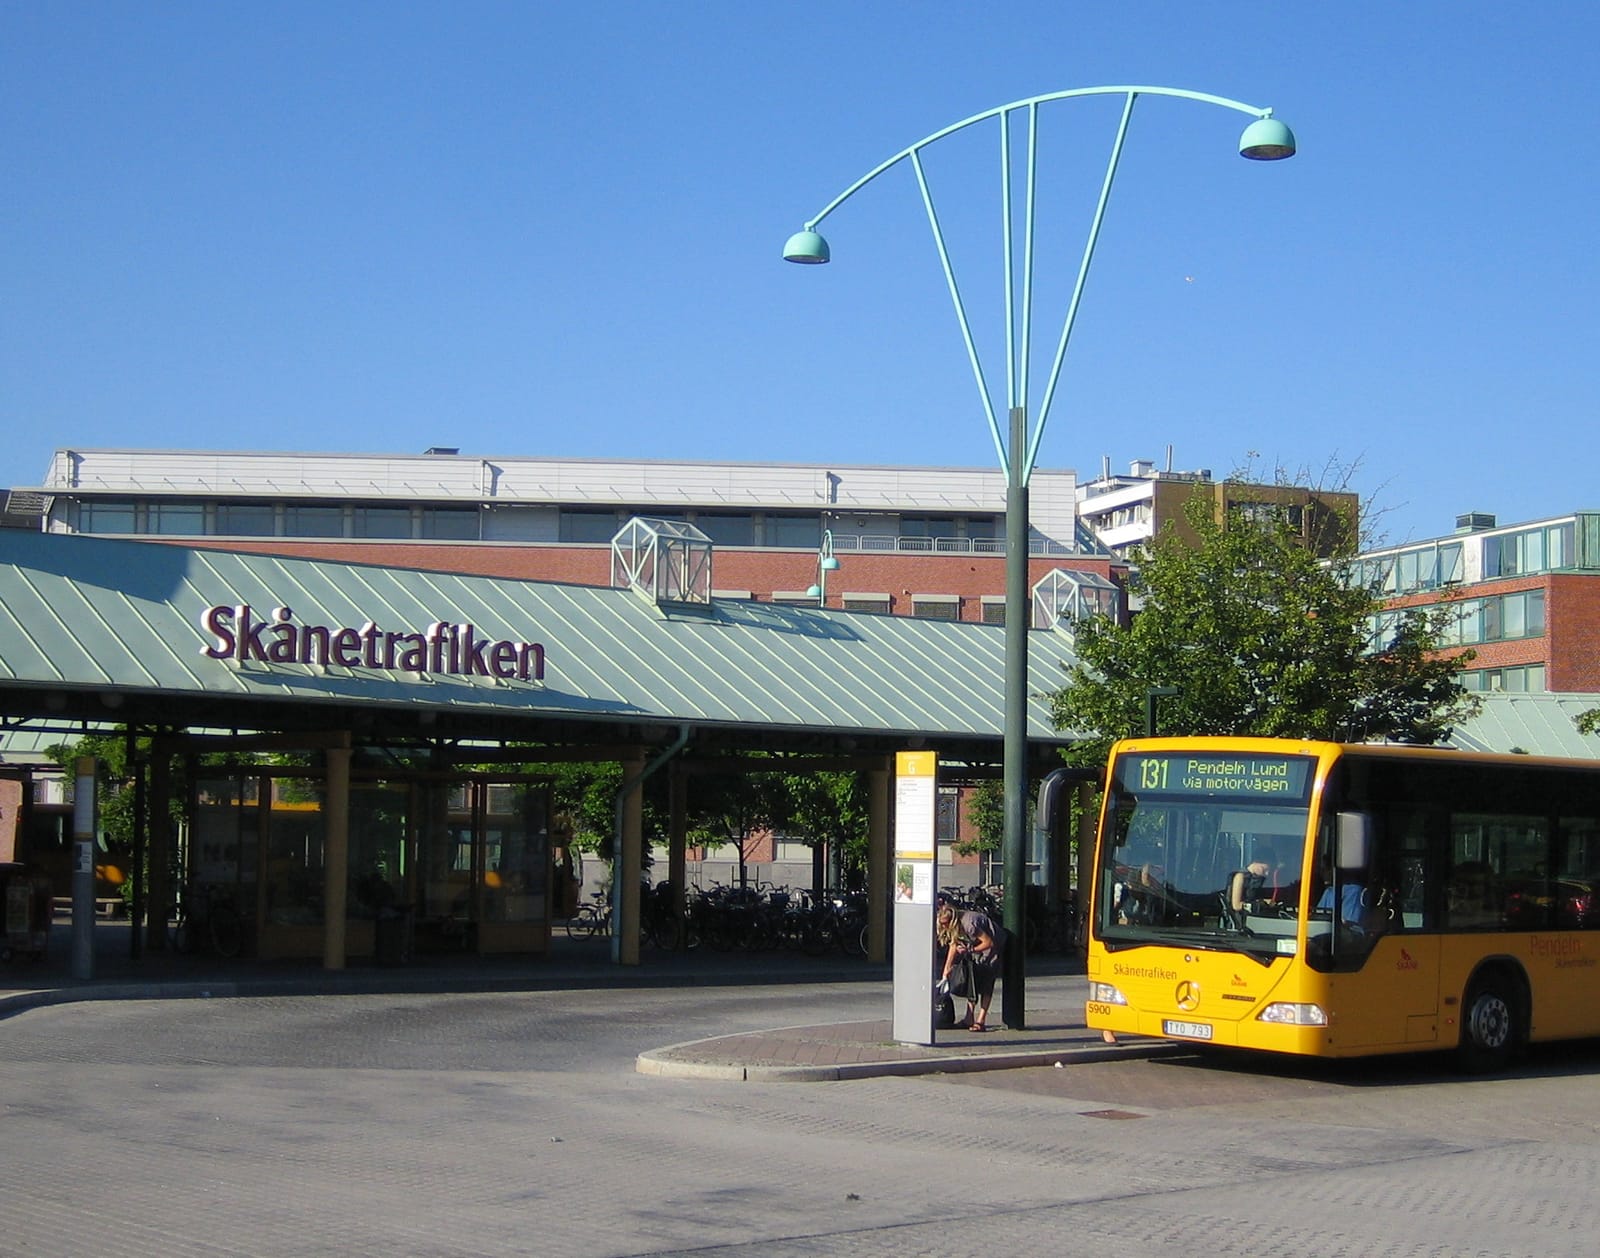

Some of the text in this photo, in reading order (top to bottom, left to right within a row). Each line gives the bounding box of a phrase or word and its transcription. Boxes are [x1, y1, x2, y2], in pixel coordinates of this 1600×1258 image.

[200, 604, 545, 680] Skånetrafiken
[1140, 759, 1169, 789] 131
[1188, 760, 1287, 776] Pendeln Lund
[1182, 777, 1289, 793] via motorvägen
[1113, 963, 1177, 980] Skånetrafiken
[1088, 1003, 1111, 1015] 5900
[1191, 1023, 1210, 1037] 793
